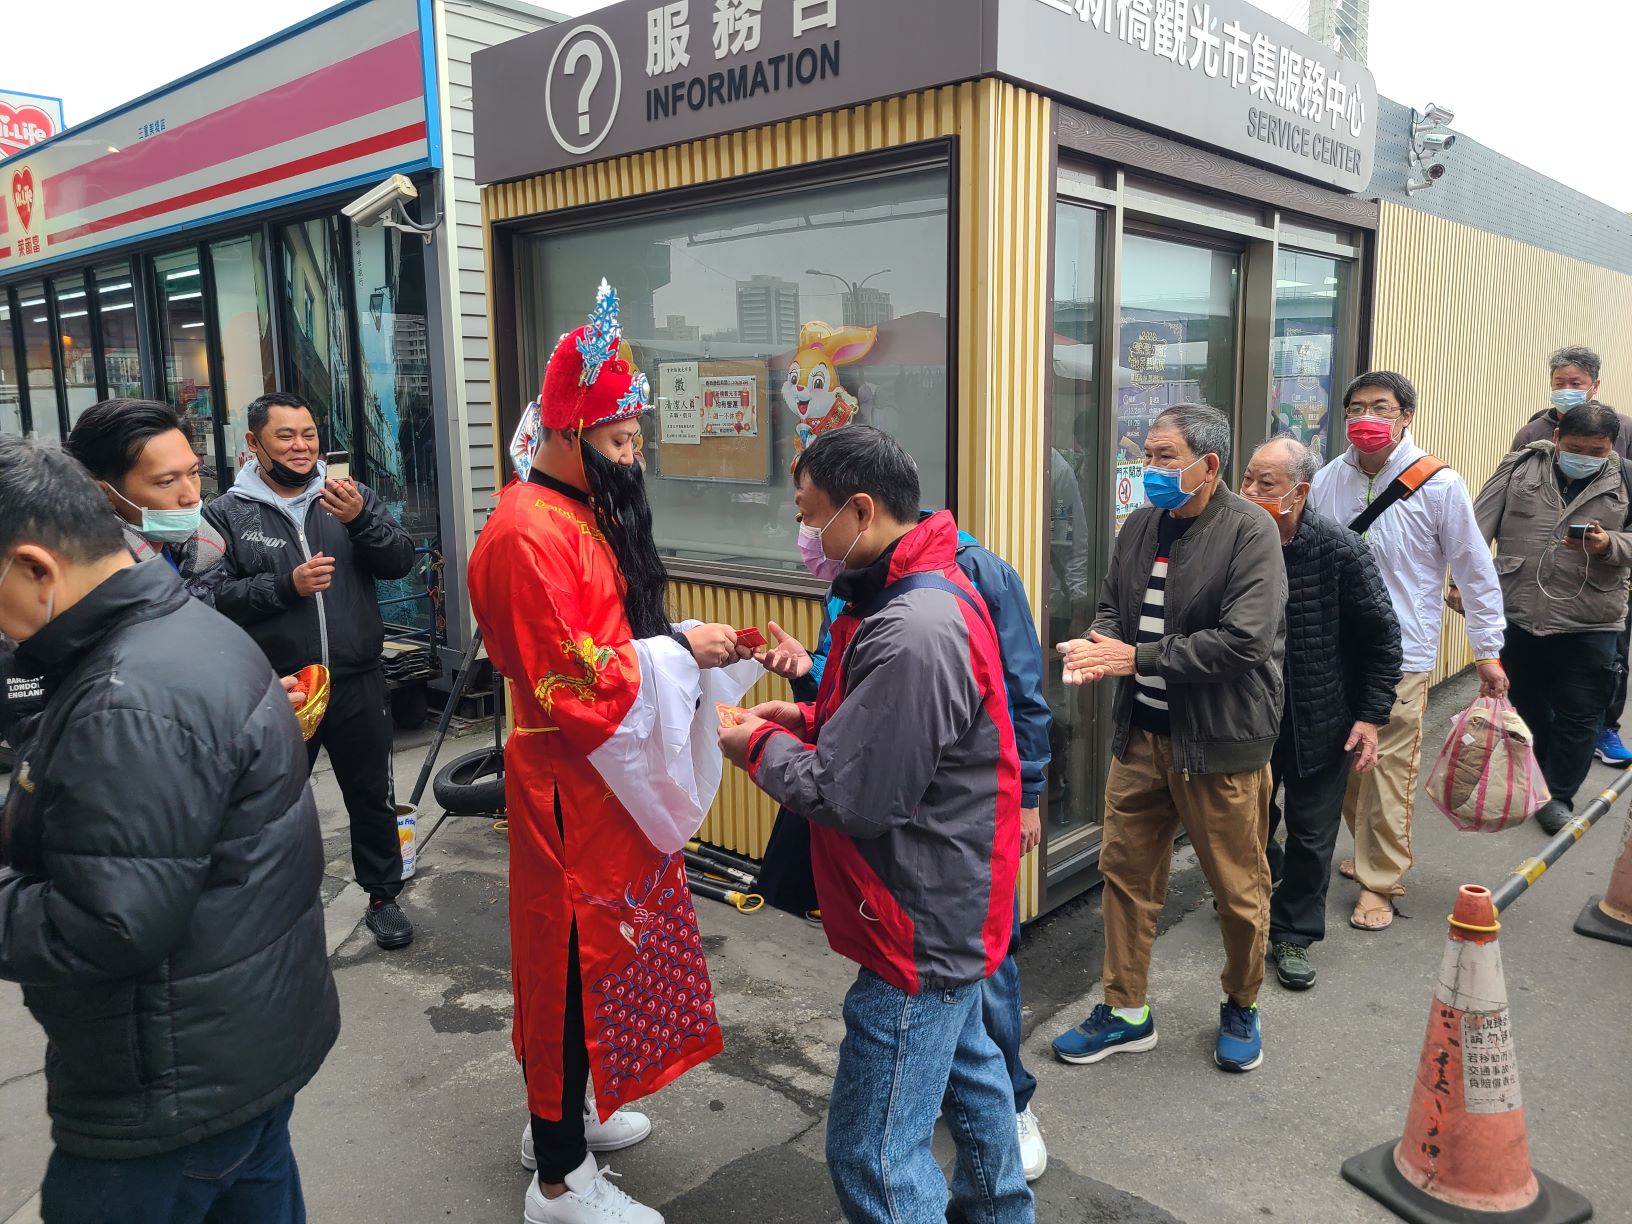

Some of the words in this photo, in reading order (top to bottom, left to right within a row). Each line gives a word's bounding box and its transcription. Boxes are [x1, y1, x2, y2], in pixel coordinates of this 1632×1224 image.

[1036, 0, 1365, 137] 橋觀光市集服務中心
[646, 40, 840, 121] INFORMATION
[0, 115, 47, 145] i-Life
[1247, 107, 1310, 158] SERVICE
[1313, 132, 1362, 176] CENTER
[664, 399, 696, 410] 清潔人員
[9, 682, 40, 692] LONDO
[1467, 1051, 1512, 1063] 若移動而
[1469, 1064, 1514, 1076] 交通事故
